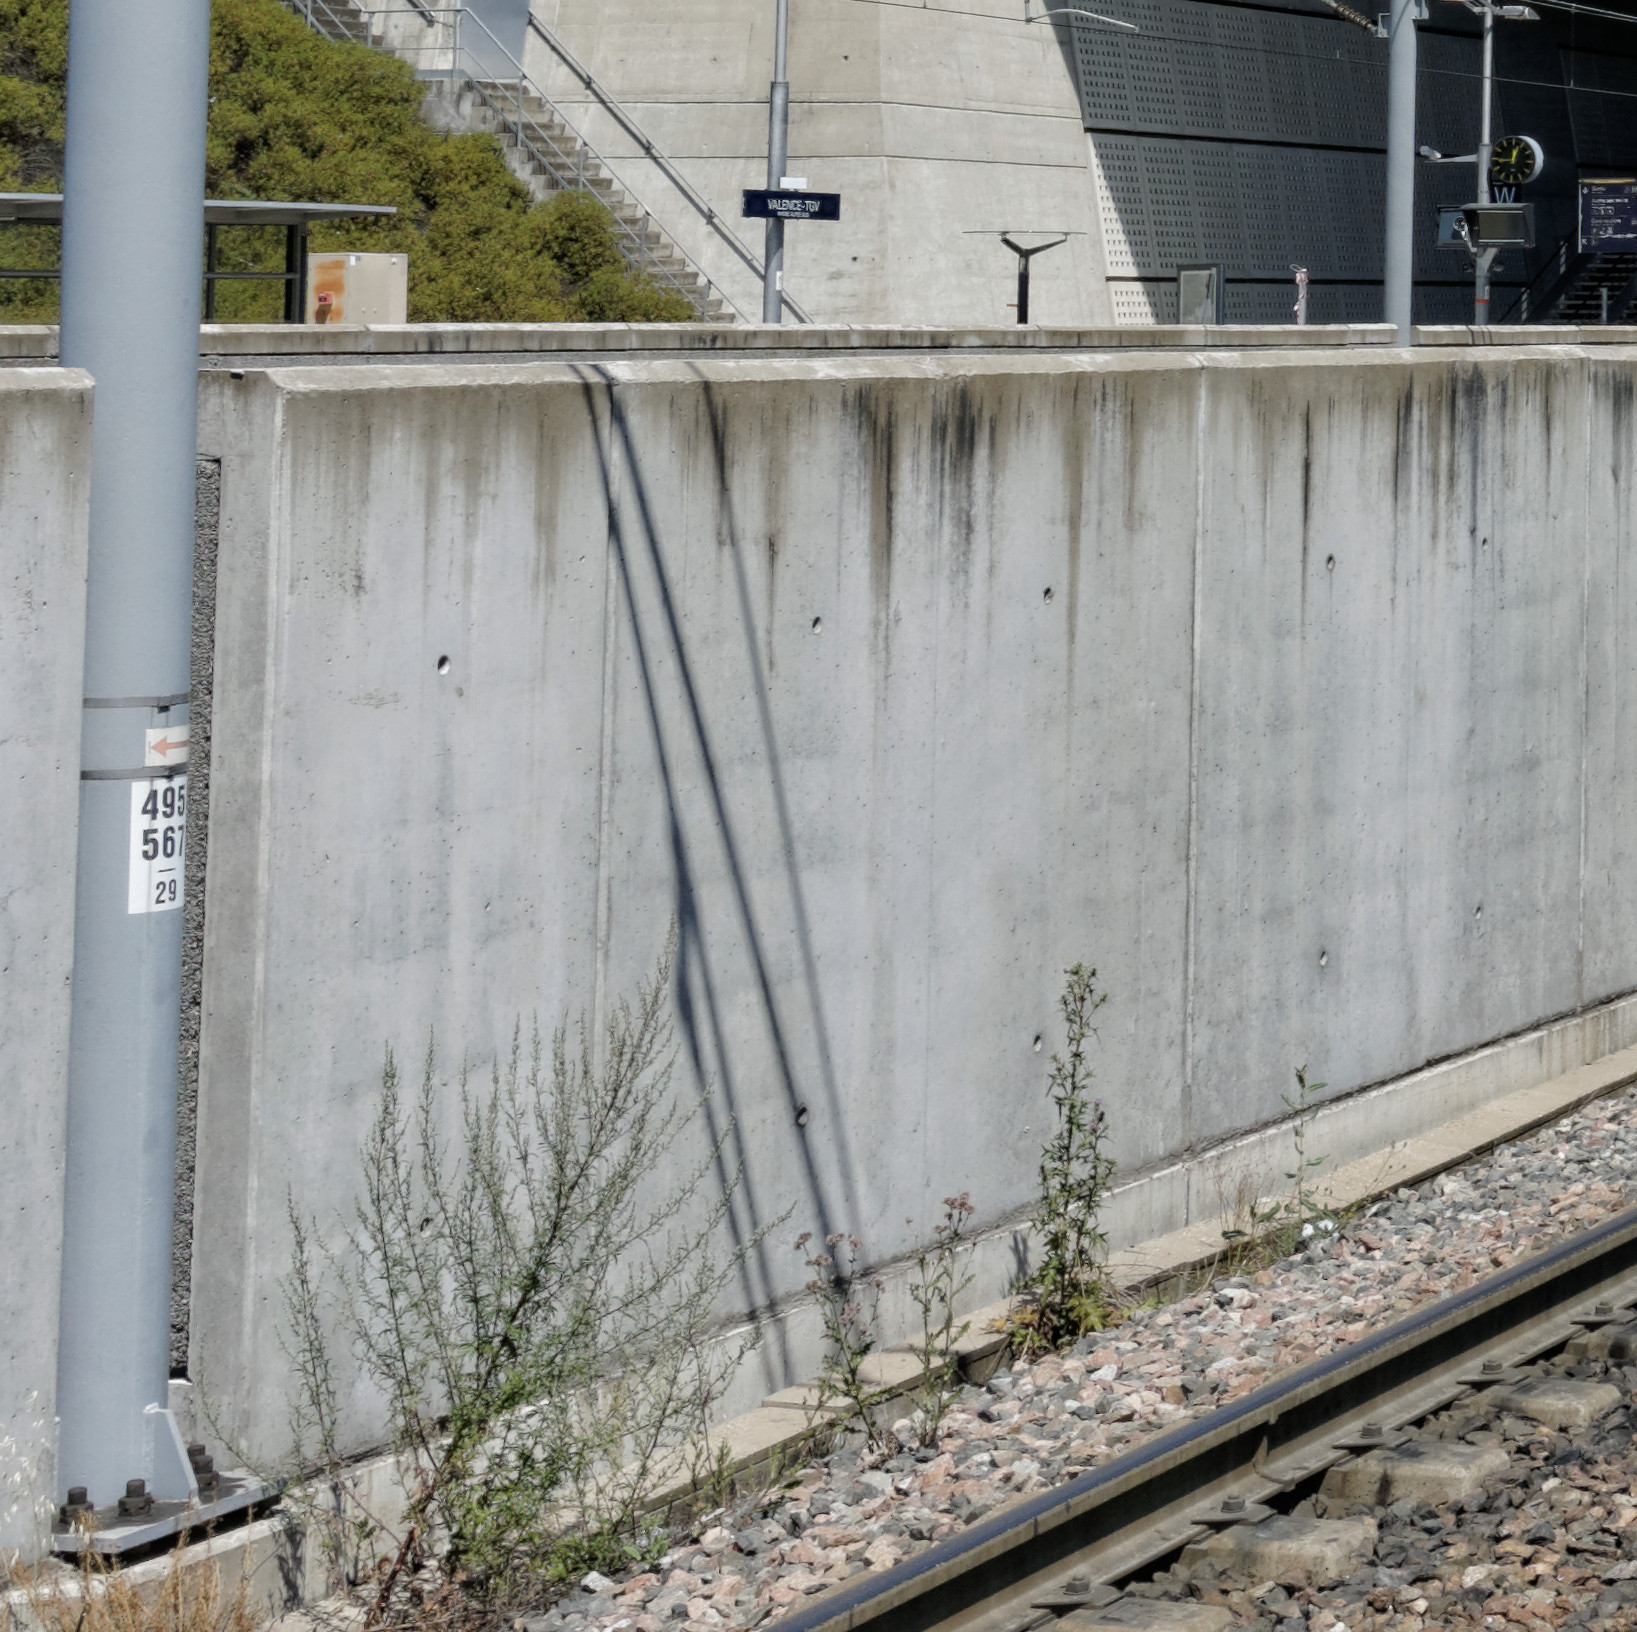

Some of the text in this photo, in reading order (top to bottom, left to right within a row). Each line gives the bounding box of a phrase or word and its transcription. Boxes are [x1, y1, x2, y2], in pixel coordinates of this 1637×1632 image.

[1494, 186, 1516, 203] W
[141, 785, 186, 820] 495
[142, 825, 185, 861] 567
[155, 879, 177, 905] 29
